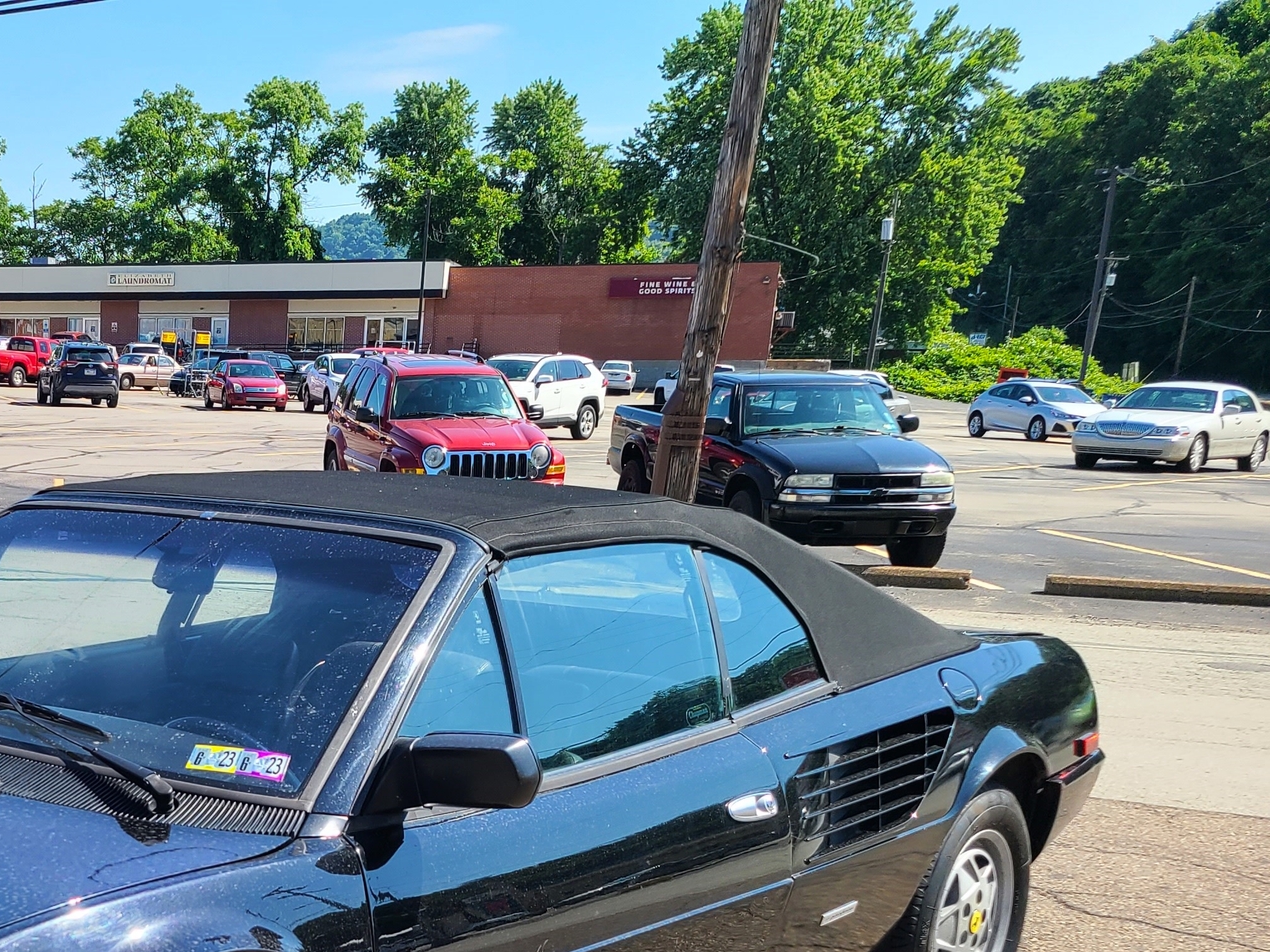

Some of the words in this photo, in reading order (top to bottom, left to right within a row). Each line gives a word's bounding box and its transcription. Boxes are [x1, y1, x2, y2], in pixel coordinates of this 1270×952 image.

[193, 751, 205, 765] 6
[218, 751, 237, 767] 23
[239, 756, 251, 771] 6
[265, 757, 283, 775] 23
